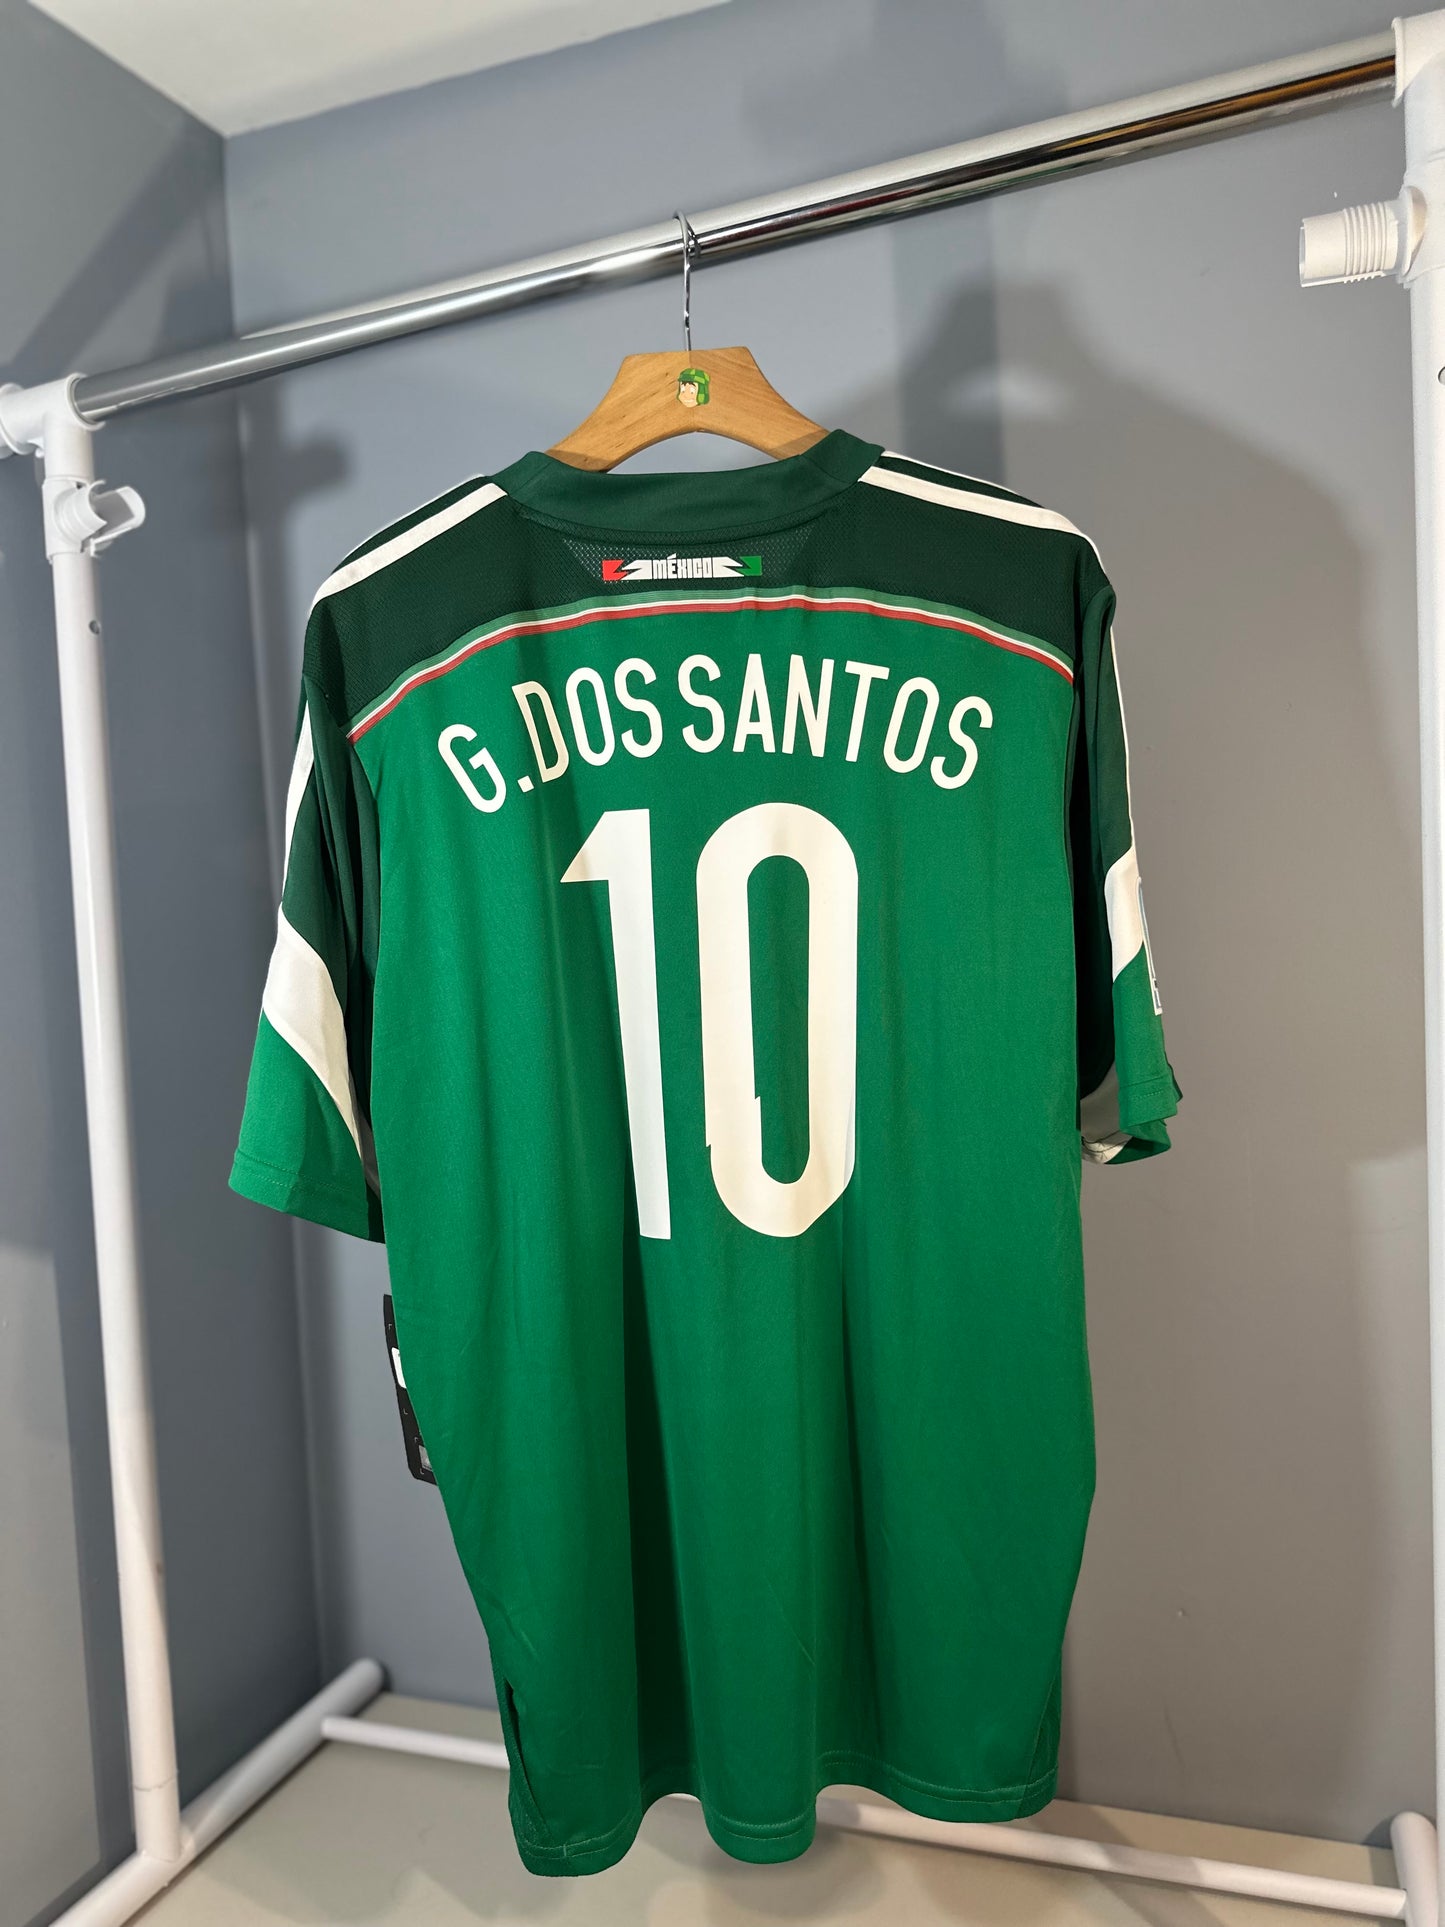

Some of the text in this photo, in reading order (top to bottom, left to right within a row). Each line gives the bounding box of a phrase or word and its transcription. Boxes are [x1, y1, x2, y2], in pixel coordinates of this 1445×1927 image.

[653, 553, 712, 579] MÉXICO
[678, 653, 993, 790] SANTOS
[560, 802, 858, 1240] 10
